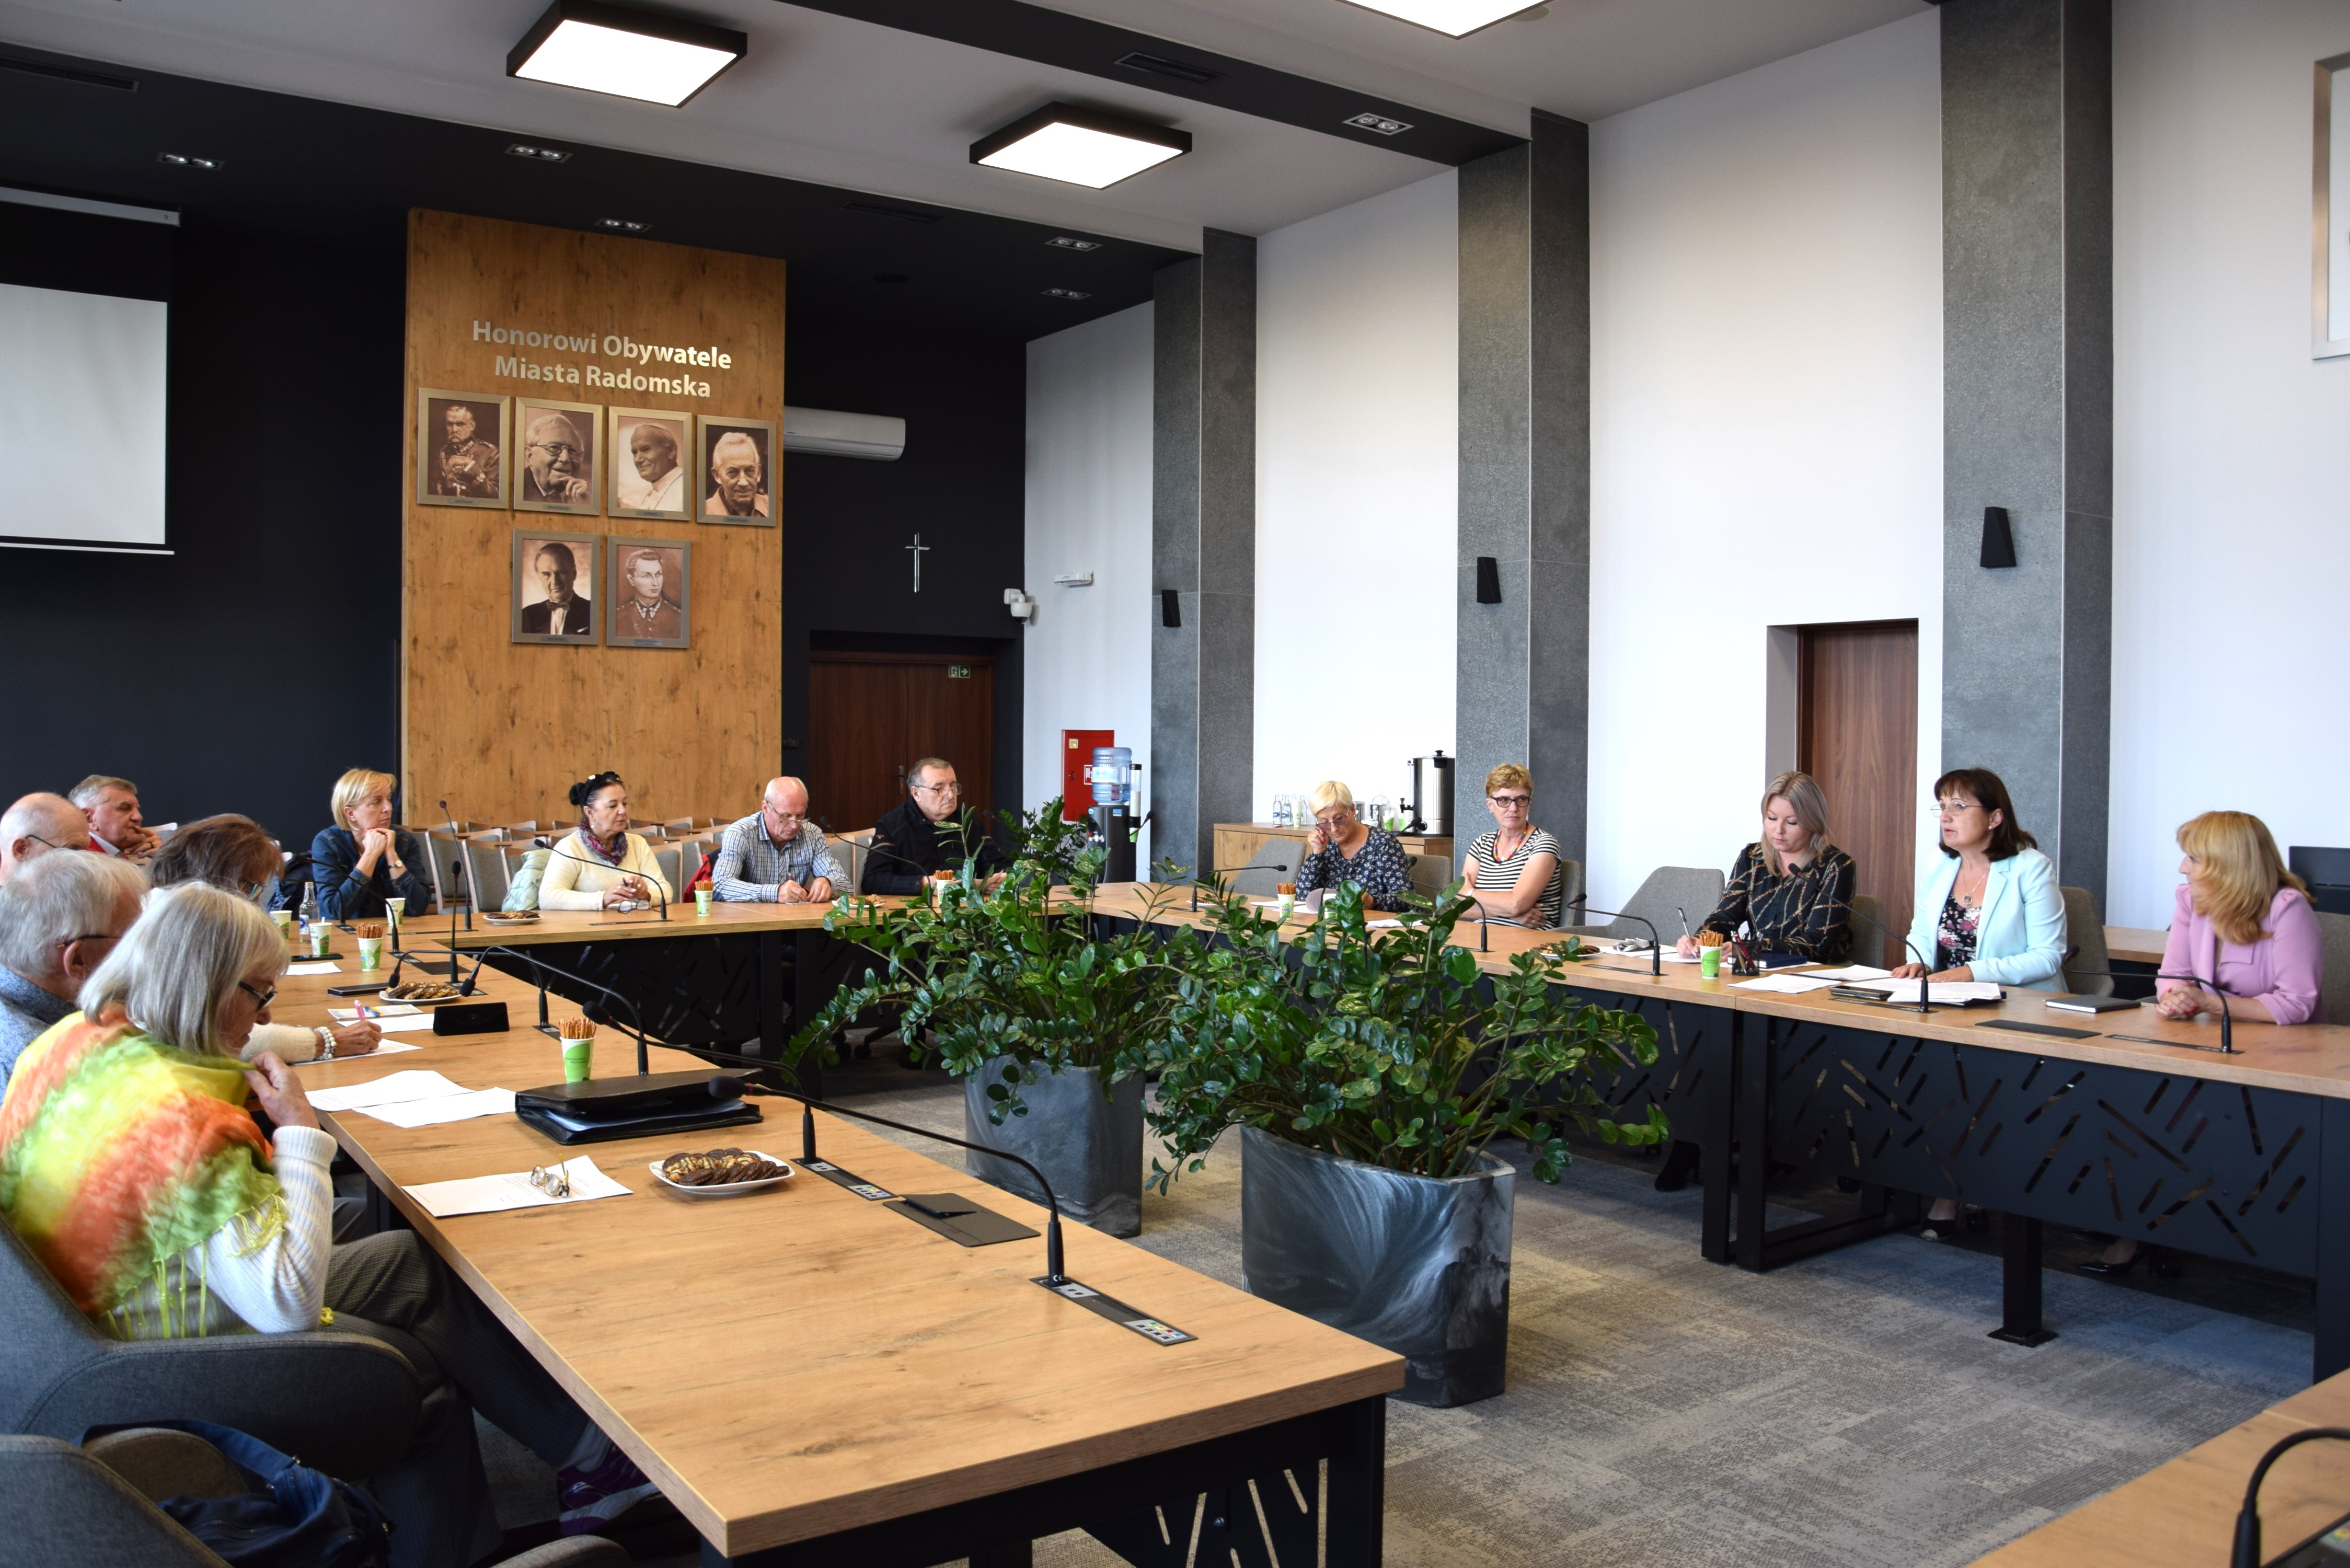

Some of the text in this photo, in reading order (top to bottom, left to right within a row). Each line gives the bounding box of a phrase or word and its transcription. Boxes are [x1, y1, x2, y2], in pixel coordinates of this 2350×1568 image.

[473, 320, 731, 369] Honorowi Obywatele
[495, 355, 710, 398] Miasta Radomska
